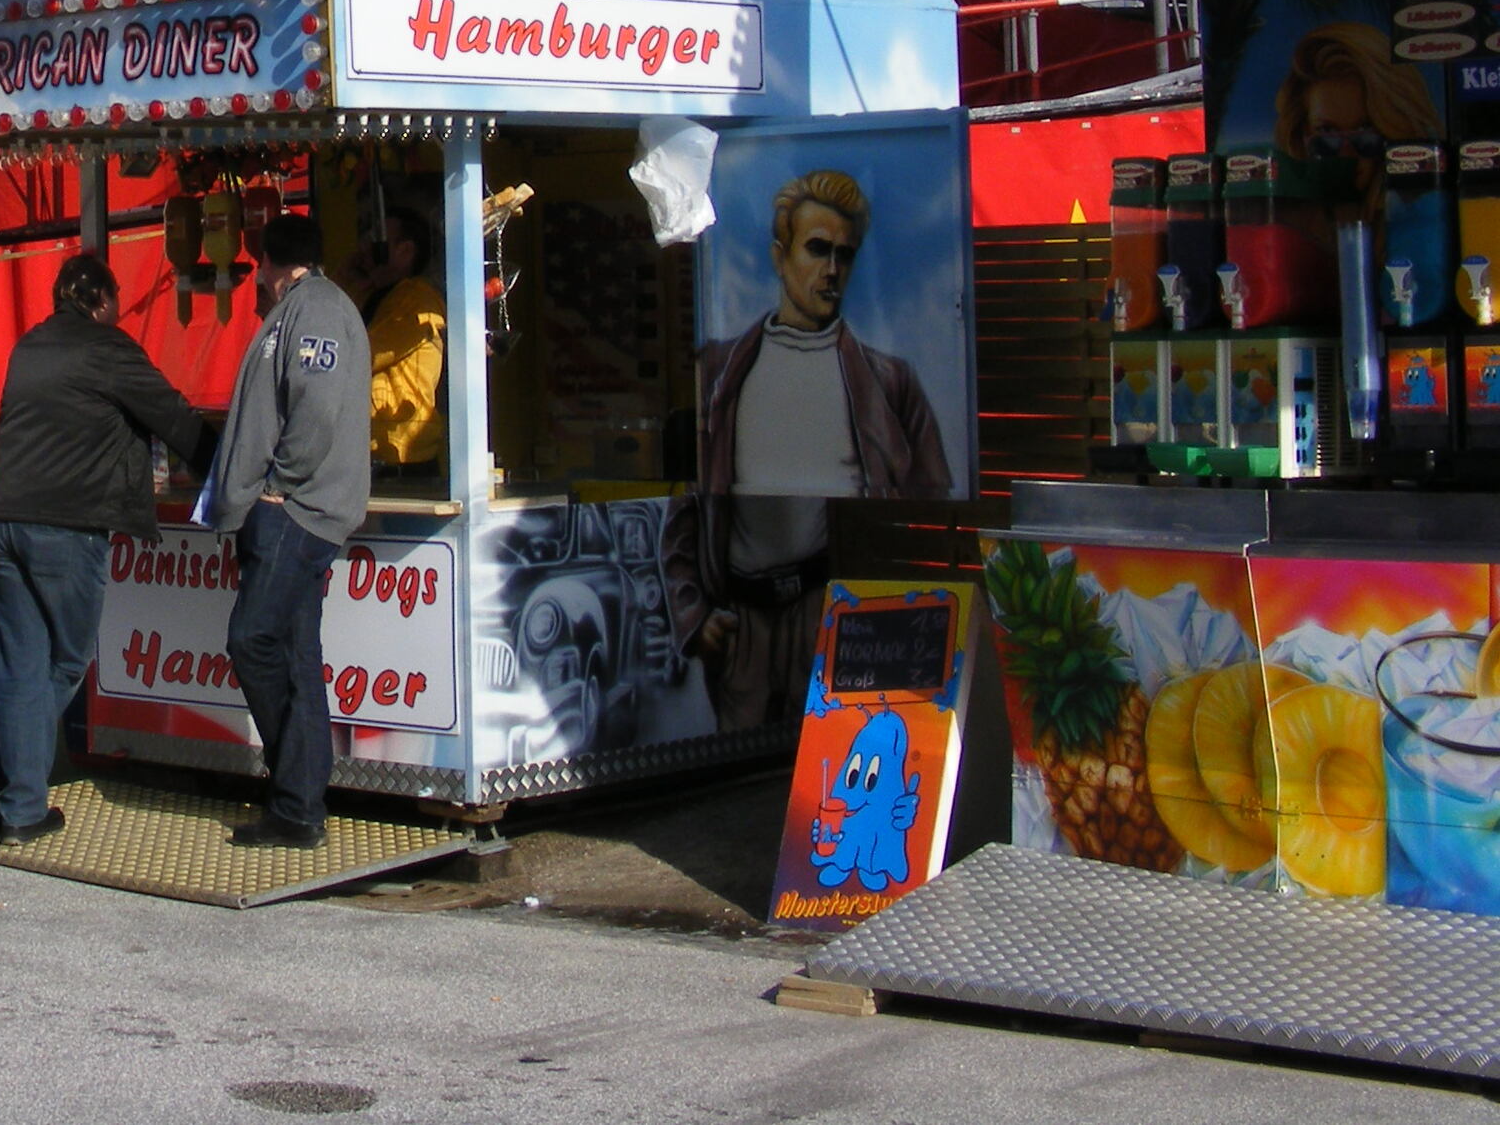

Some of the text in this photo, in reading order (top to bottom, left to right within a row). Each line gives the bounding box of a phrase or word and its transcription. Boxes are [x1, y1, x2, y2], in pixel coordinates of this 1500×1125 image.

[122, 11, 262, 81] DINER
[300, 336, 338, 371] 75
[110, 532, 242, 591] Dänisch
[347, 544, 439, 617] Dogs
